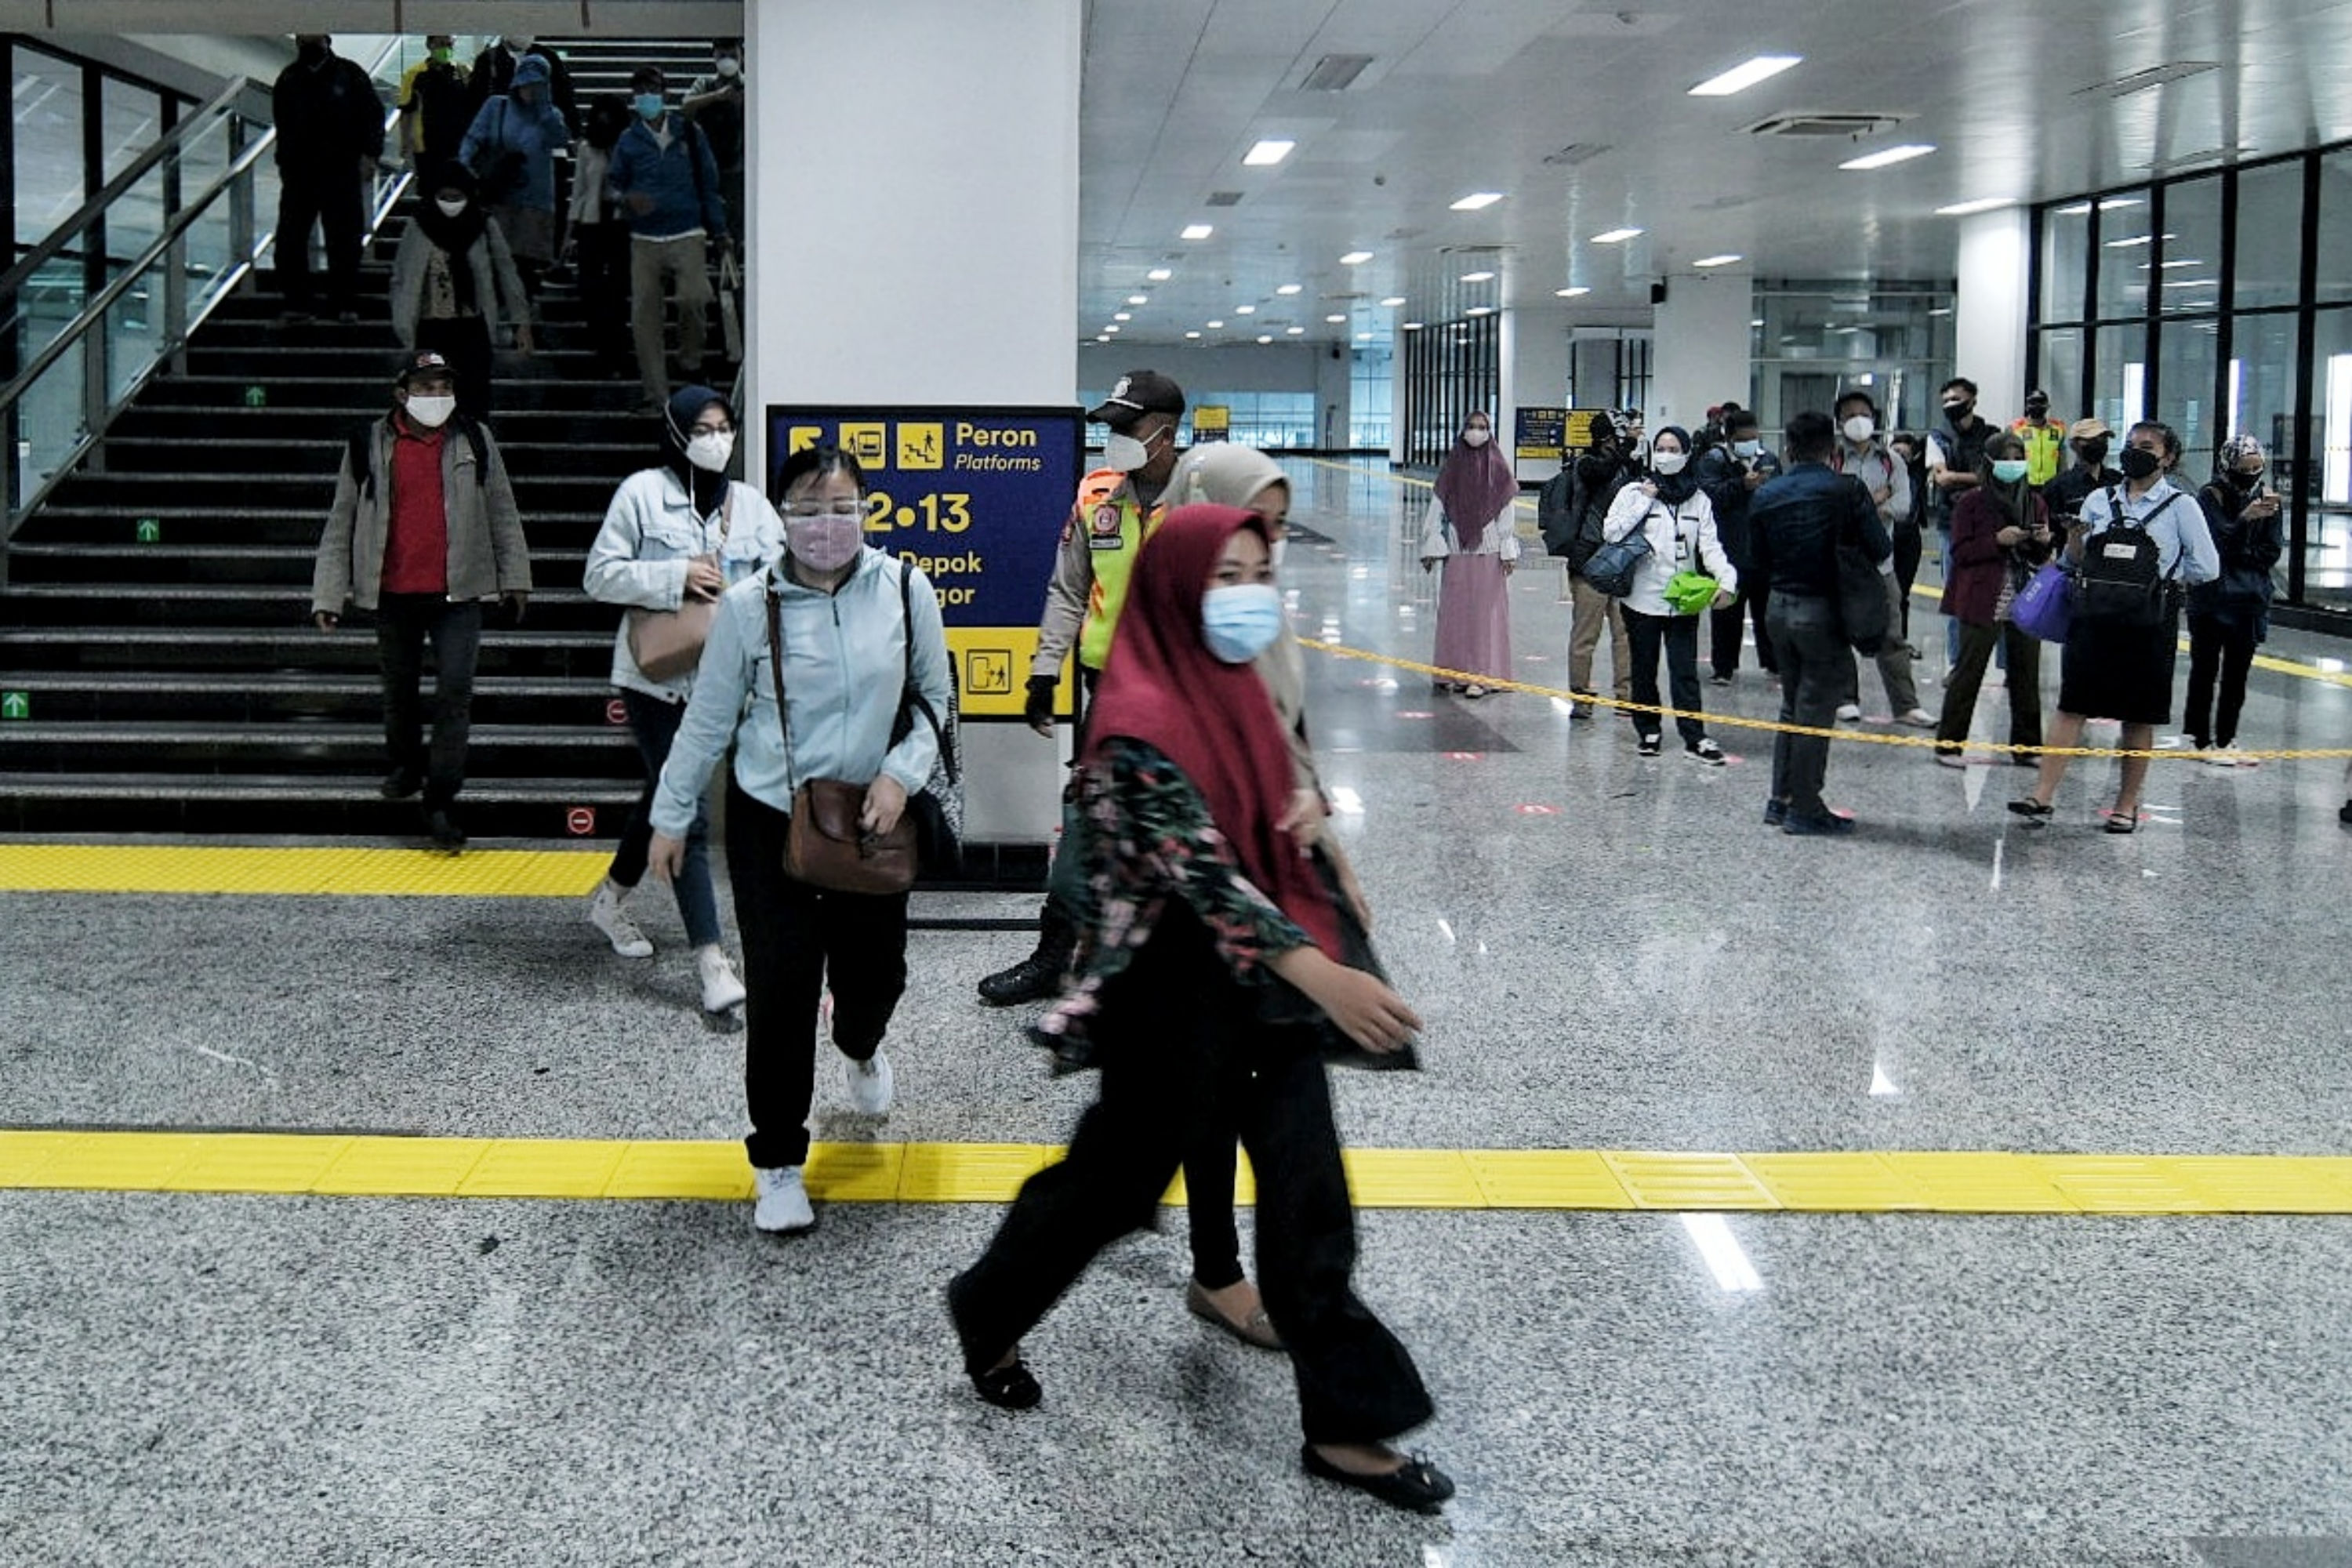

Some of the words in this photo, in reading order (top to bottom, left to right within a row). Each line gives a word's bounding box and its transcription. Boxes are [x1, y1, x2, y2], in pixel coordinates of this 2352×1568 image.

[956, 423, 1036, 447] Peron
[954, 454, 1041, 470] Platforms
[898, 550, 982, 578] Depok
[934, 588, 975, 608] gor
